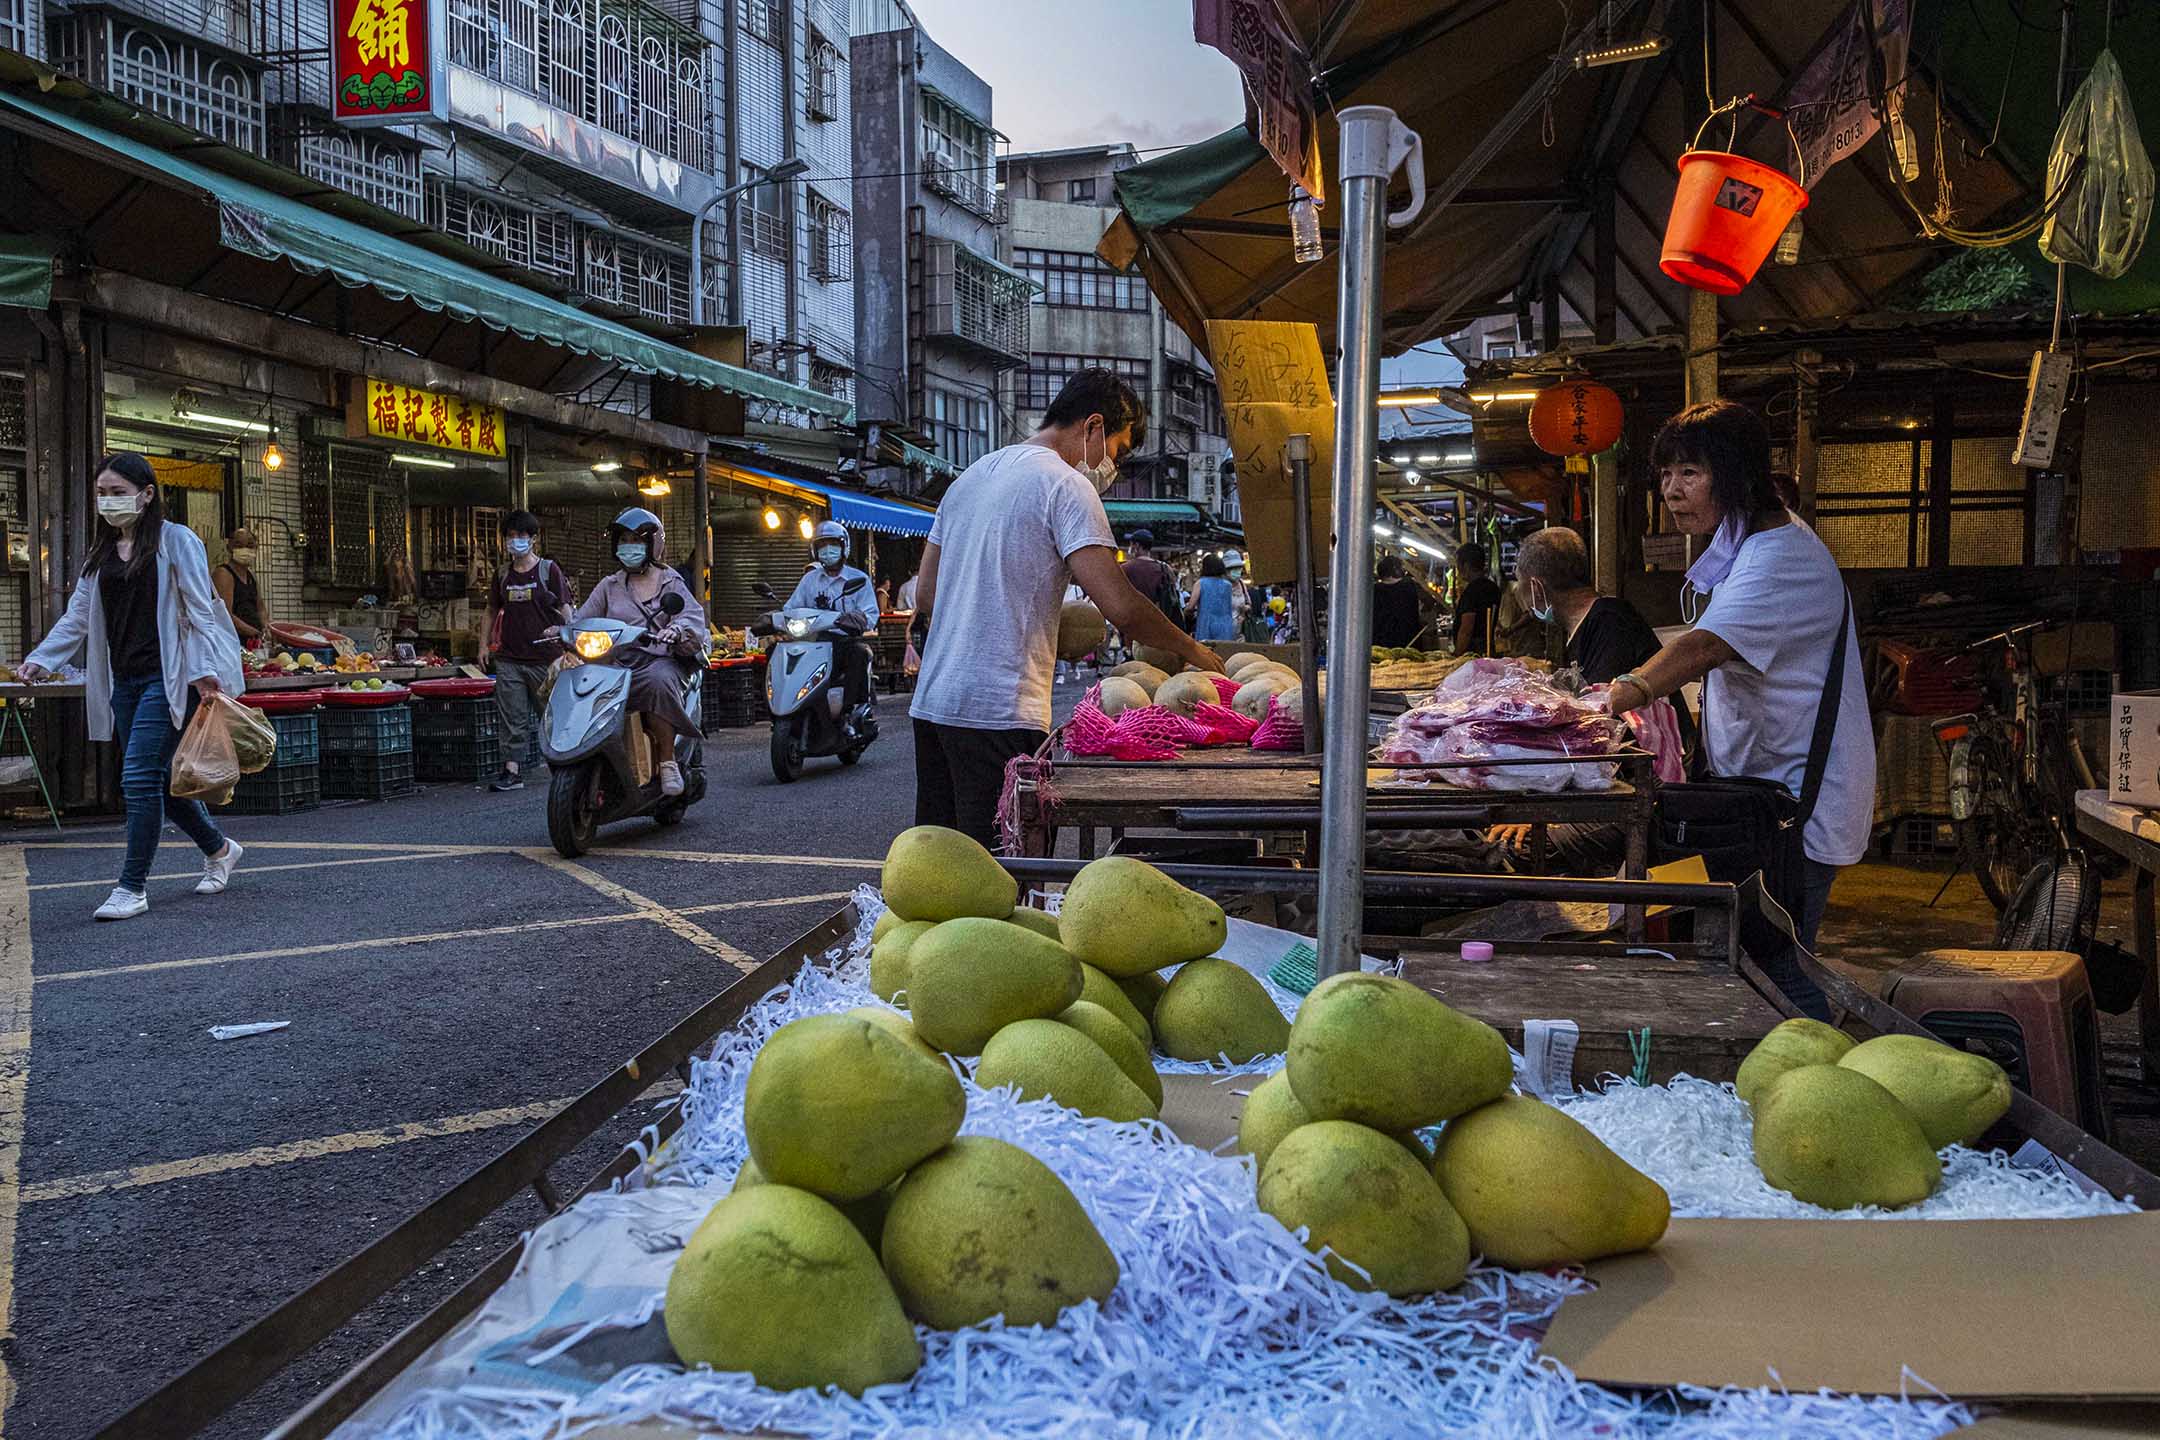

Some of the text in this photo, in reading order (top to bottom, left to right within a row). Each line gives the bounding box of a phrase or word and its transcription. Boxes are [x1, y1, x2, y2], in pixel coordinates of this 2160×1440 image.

[373, 383, 500, 456] 福記製香廠
[1569, 384, 1590, 446] 合家平安
[2118, 705, 2133, 793] 品質保証
